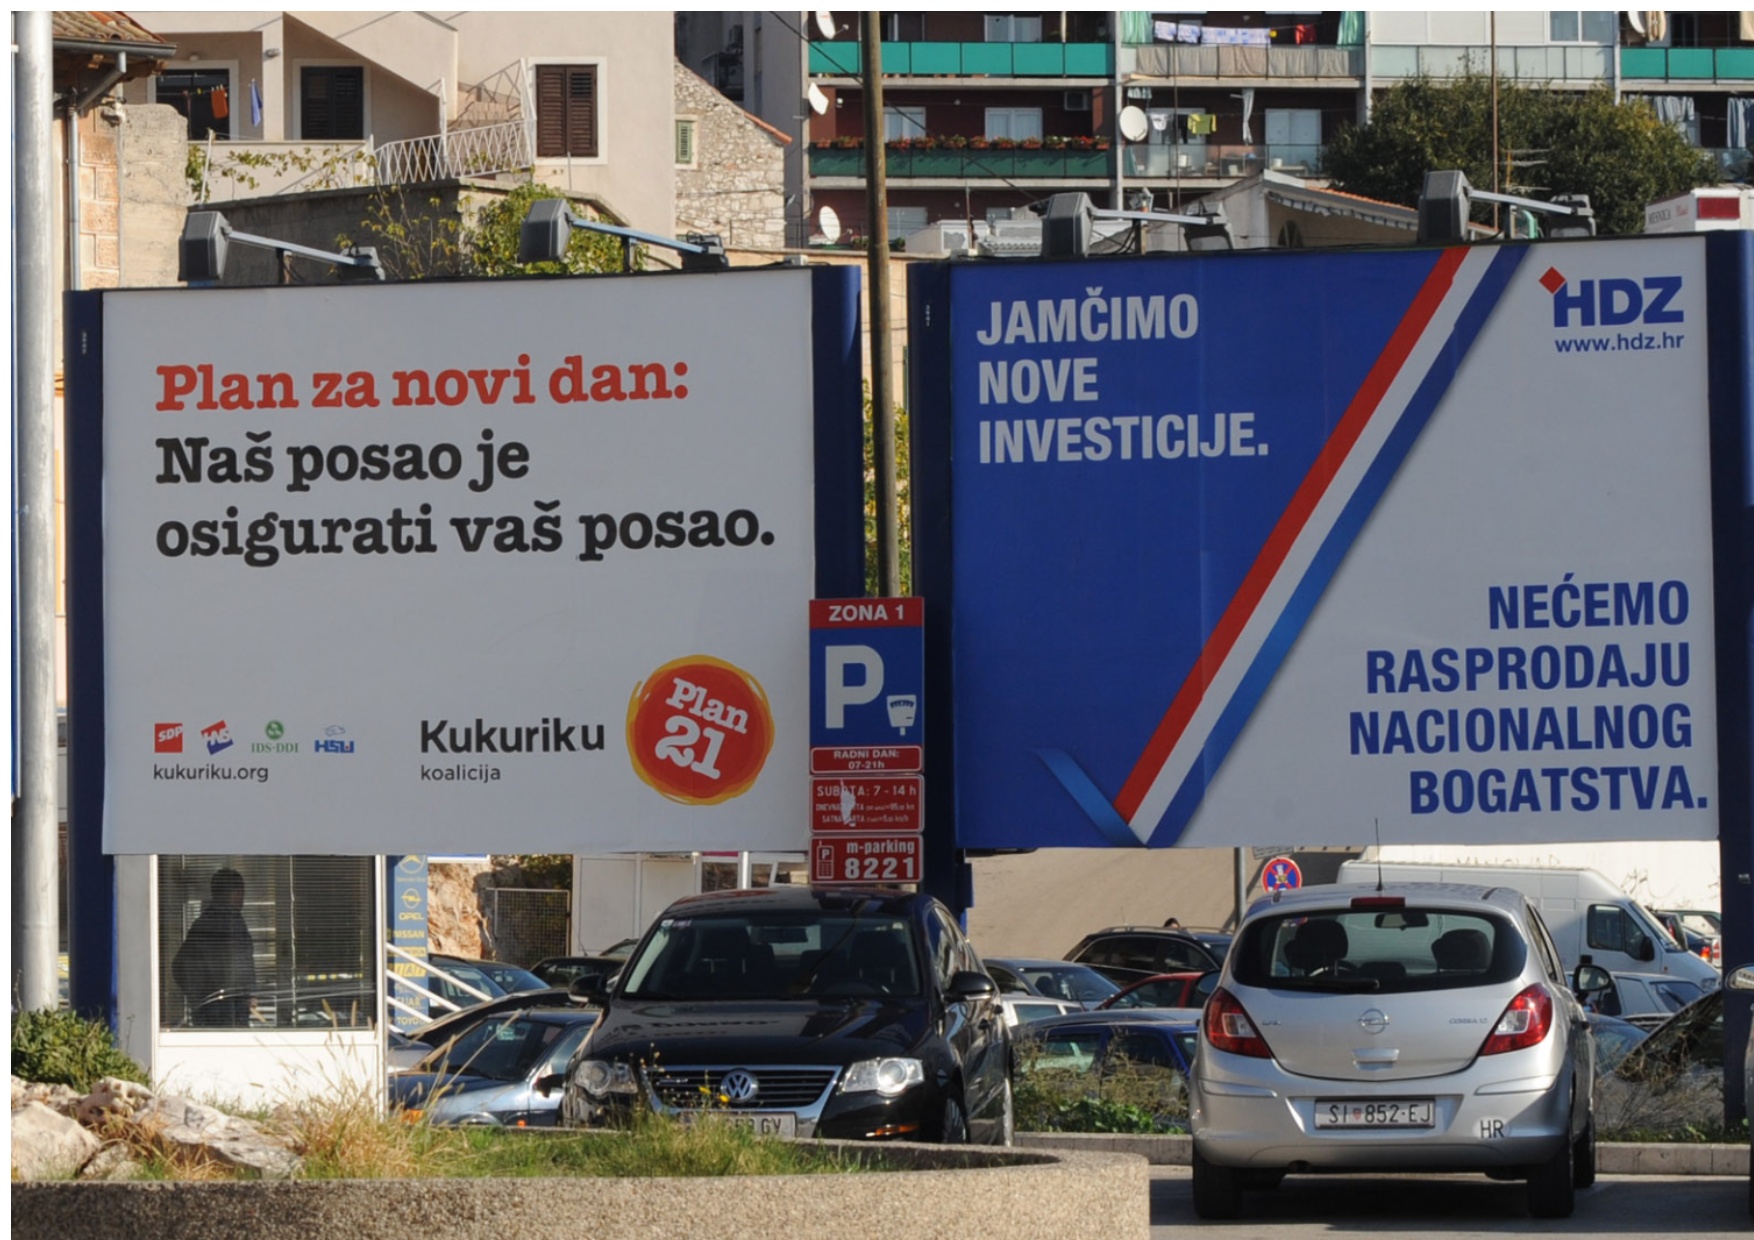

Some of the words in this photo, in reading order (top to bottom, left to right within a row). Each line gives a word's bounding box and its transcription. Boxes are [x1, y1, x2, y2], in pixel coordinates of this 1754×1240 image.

[977, 287, 1198, 345] JAMČIMO
[1553, 275, 1685, 328] HDZ
[1555, 332, 1685, 355] www.hdz.hr
[155, 363, 299, 411] Plan
[312, 369, 380, 408] za
[393, 354, 536, 406] novi
[549, 355, 689, 404] dan:
[978, 358, 1099, 405] NOVE
[155, 430, 274, 484] Naš
[286, 441, 463, 492] posao
[468, 428, 530, 492] je
[978, 413, 1269, 464] INVESTICIJE.
[156, 503, 438, 567] osigurati
[449, 500, 563, 553] vaš
[577, 509, 775, 561] posao.
[829, 604, 888, 622] ZONA
[895, 604, 904, 621] 1
[1488, 573, 1690, 630] NEĆEMO
[825, 645, 884, 729] P
[1366, 641, 1691, 694] RASPRODAJU
[664, 676, 749, 736] Plan
[1349, 704, 1693, 755] NACIONALNOG
[157, 726, 183, 743] SDP
[251, 742, 299, 753] IDS-DDI
[314, 740, 354, 753] HSU
[420, 718, 605, 754] Kukuriku
[654, 714, 726, 780] 21
[834, 750, 869, 759] RADNI
[872, 749, 900, 758] DAN:
[153, 764, 269, 783] kukuriku.org
[420, 764, 501, 783] koalicija
[848, 761, 885, 770] 07-21h
[874, 785, 881, 796] 7
[893, 785, 905, 796] 14
[909, 785, 916, 795] h
[1410, 766, 1708, 815] BOGATSTVA.
[845, 857, 914, 879] 8221
[846, 839, 915, 855] m-parking
[1329, 1106, 1347, 1124] SI
[1480, 1120, 1504, 1138] HR
